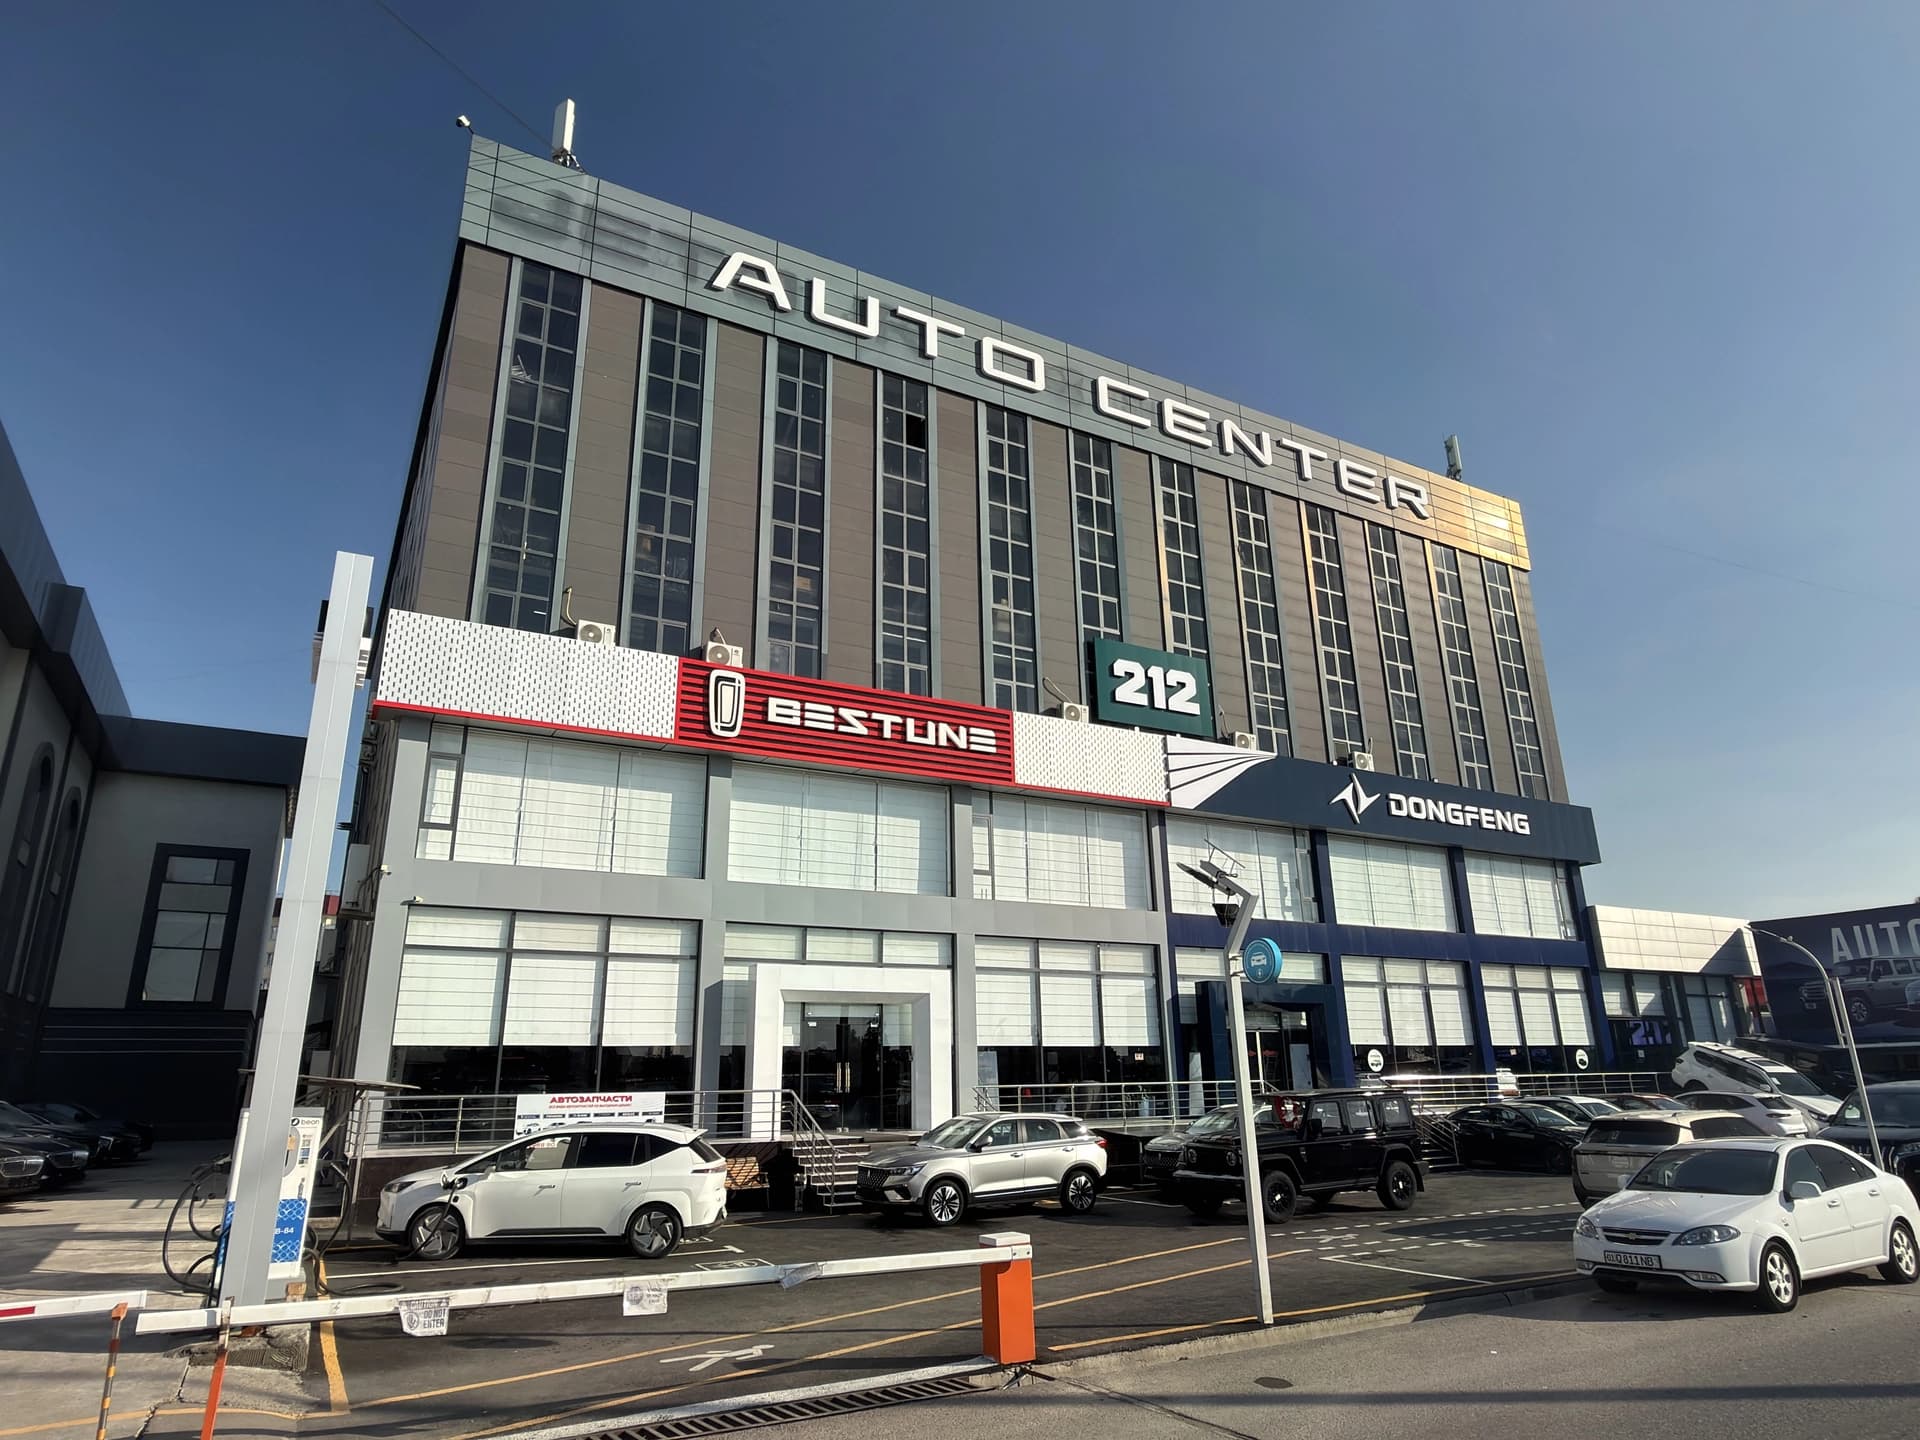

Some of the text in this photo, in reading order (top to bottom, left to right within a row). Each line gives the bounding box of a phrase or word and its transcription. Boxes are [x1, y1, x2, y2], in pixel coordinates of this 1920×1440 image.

[710, 251, 1431, 520] AUTO CENTER
[1112, 658, 1201, 716] 212
[767, 695, 998, 754] BESTUNE
[1388, 792, 1532, 836] DONGFENG
[550, 1095, 633, 1104] АВТОЗАПЧАСТИ
